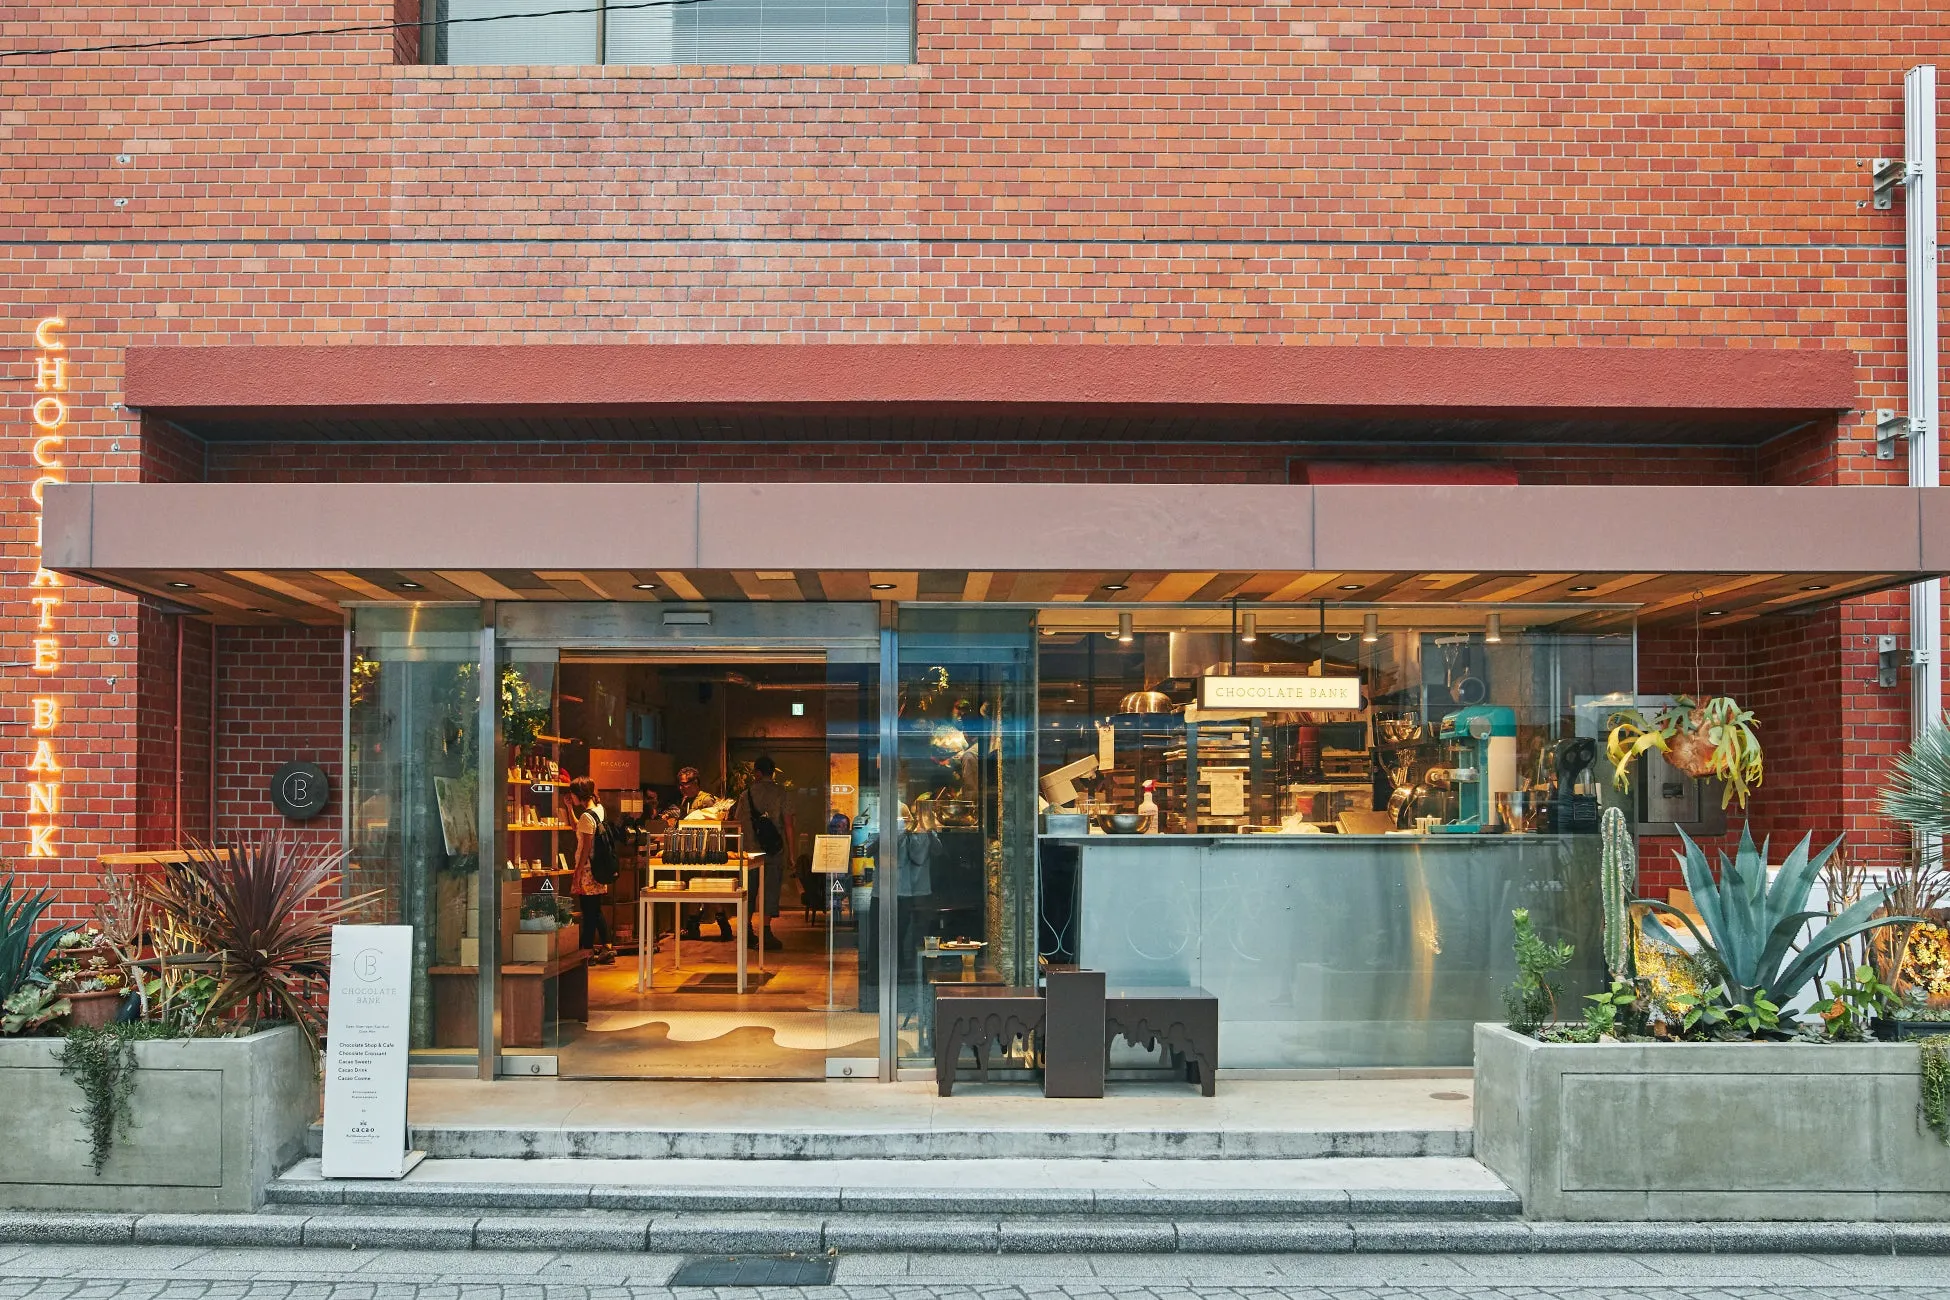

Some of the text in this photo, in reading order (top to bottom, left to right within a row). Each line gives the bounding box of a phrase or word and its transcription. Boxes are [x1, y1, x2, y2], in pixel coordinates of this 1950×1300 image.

[1215, 687, 1349, 699] CHOCOLATE BANK
[28, 698, 59, 857] BANK
[341, 987, 397, 995] CHOCOLATE
[356, 996, 381, 1004] BANK
